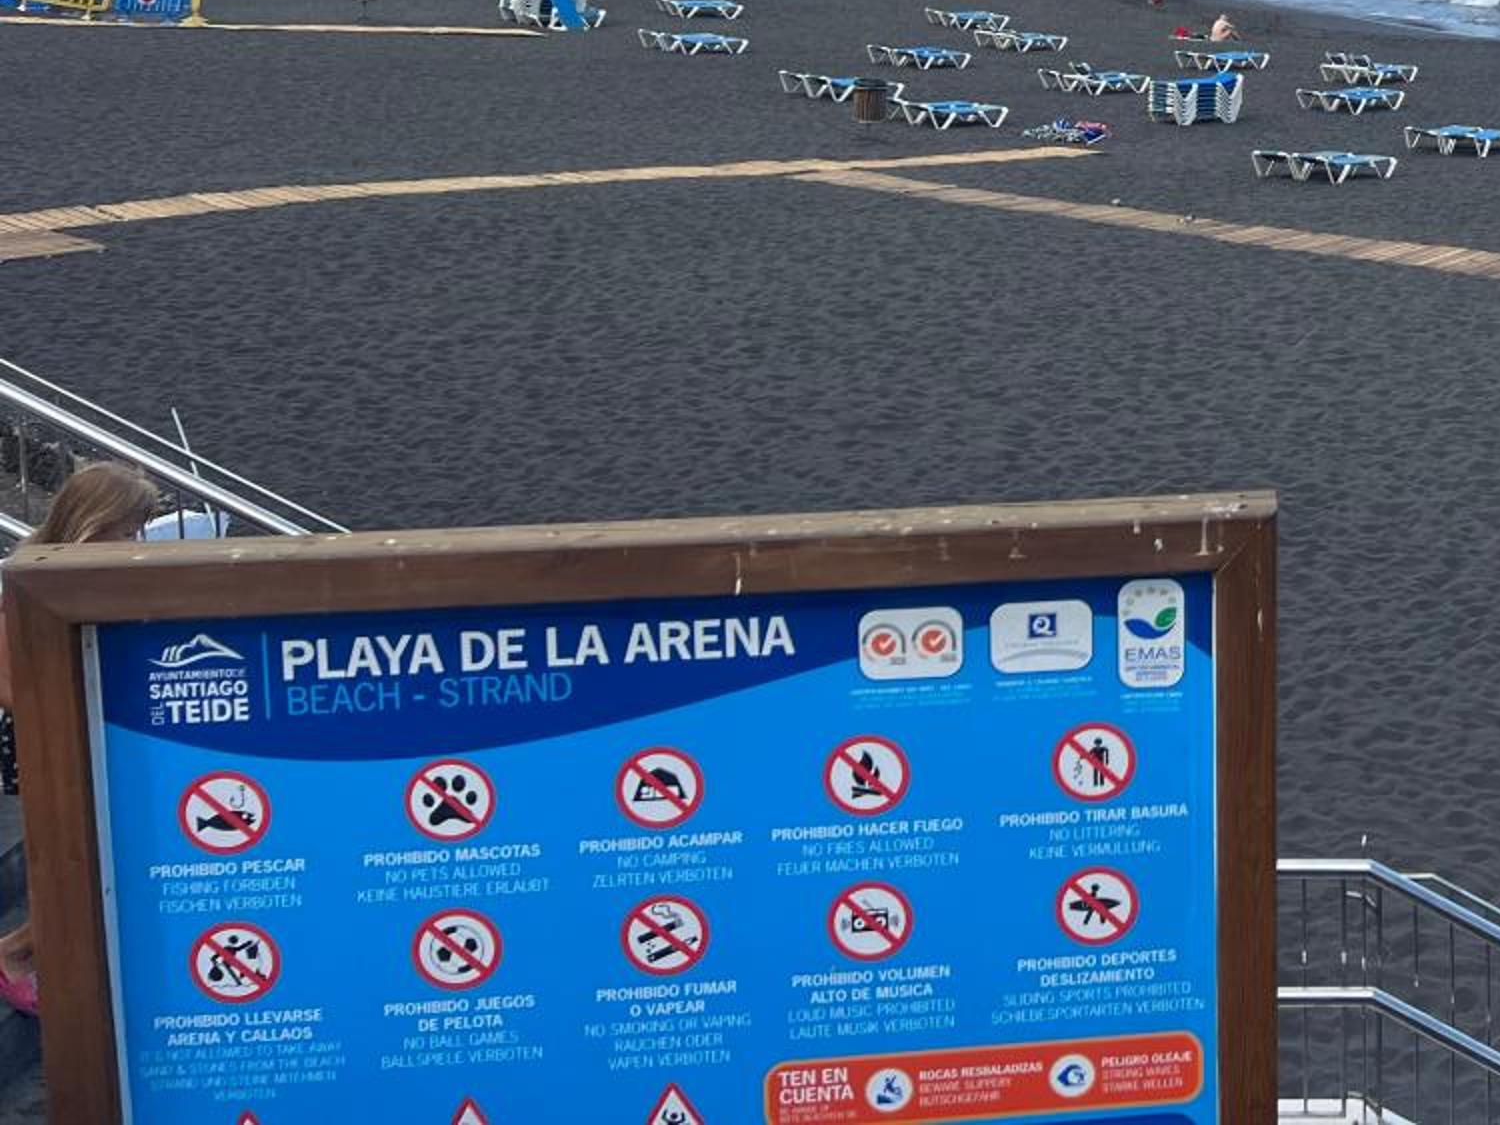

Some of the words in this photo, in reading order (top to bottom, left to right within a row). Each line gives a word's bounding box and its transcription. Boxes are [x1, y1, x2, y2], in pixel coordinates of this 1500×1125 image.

[281, 633, 444, 681] PLAYA
[460, 628, 528, 672] DE
[546, 625, 609, 667] LA
[624, 616, 795, 663] ARENA
[1124, 646, 1181, 662] EMAS
[149, 680, 248, 700] SANTIAGO
[287, 682, 401, 716] BEACH
[439, 673, 573, 708] STRAND
[151, 702, 165, 726] DEL
[165, 698, 250, 724] TEIDE
[1000, 811, 1080, 827] PROHIBIDO
[1084, 808, 1127, 823] TIRAR
[1131, 802, 1188, 820] BASURA
[771, 825, 853, 841] PROHIBIDO
[858, 822, 909, 837] HACER
[913, 818, 964, 833] FUEGO
[1049, 826, 1070, 841] NO
[1073, 823, 1141, 840] LITTERING
[579, 836, 663, 854] PROHIBIDO
[667, 831, 743, 849] ACAMPAR
[802, 843, 823, 857] NO
[827, 840, 865, 856] FIRES
[868, 836, 935, 853] ALLOWED
[1029, 844, 1065, 859] KEINE
[363, 850, 450, 867] PROHIBIDO
[455, 844, 541, 862] MASCOTAS
[617, 855, 639, 869] NO
[643, 851, 707, 868] CAMPING
[777, 860, 821, 876] FEUER
[825, 857, 884, 873] MACHEN
[887, 852, 960, 869] VERBOTEN
[149, 862, 237, 879] PROHIBIDO
[241, 858, 305, 875] PESCAR
[385, 869, 407, 885] NO
[411, 866, 449, 882] PETS
[452, 862, 521, 880] ALLOWED
[658, 867, 733, 884] VERBOTEN
[162, 880, 219, 896] FISHING
[357, 888, 399, 903] KEINE
[403, 883, 481, 901] HAUSTIERE
[486, 878, 549, 896] ERLAUBT
[159, 897, 221, 914] FISCHEN
[225, 894, 303, 912] VERBOTEN
[1017, 955, 1097, 972] PROHIBIDO
[1101, 949, 1177, 967] DEPORTES
[878, 964, 951, 982] VOLUMEN
[1040, 967, 1155, 988] DESLIZAMIENTO
[596, 984, 680, 1002] PROHIBIDO
[685, 980, 737, 996] FUMAR
[810, 989, 847, 1004] ALTO
[851, 987, 872, 1001] DE
[1059, 987, 1113, 1003] SPORTS
[1115, 981, 1192, 1000] PROHIBITED
[383, 999, 469, 1016] PROHIBIDO
[474, 994, 536, 1012] JUEGOS
[630, 1004, 642, 1018] O
[646, 1000, 705, 1017] VAPEAR
[787, 1008, 827, 1023] LOUD
[829, 1004, 874, 1020] MUSIC
[876, 998, 956, 1017] PROHIBITED
[1136, 997, 1205, 1014] VERBOTEN
[153, 1012, 240, 1030] PROHIBIDO
[244, 1008, 322, 1026] LLEVARSE
[418, 1018, 440, 1032] DE
[444, 1014, 503, 1031] PELOTA
[584, 1024, 606, 1038] NO
[610, 1020, 675, 1036] SMOKING
[679, 1017, 698, 1031] OR
[702, 1013, 752, 1029] VAPING
[789, 1025, 833, 1040] LAUTE
[837, 1021, 880, 1037] MUSIK
[883, 1015, 956, 1033] VERBOTEN
[167, 1031, 221, 1047] ARENA
[225, 1030, 236, 1044] Y
[240, 1026, 313, 1042] CALLAOS
[403, 1036, 425, 1051] NO
[429, 1034, 465, 1049] BALL
[469, 1030, 520, 1046] GAMES
[614, 1035, 682, 1053] RAUCHEN
[686, 1032, 723, 1047] ODER
[381, 1051, 465, 1069] BALLSPIELE
[468, 1046, 543, 1064] VERBOTEN
[608, 1055, 653, 1071] VAPEN
[657, 1050, 731, 1067] VERBOTEN
[1101, 1054, 1149, 1068] PELIGRO
[1151, 1050, 1193, 1064] OLEAJE
[777, 1069, 817, 1087] TEN
[821, 1066, 848, 1084] EN
[919, 1068, 959, 1081] ROCAS
[961, 1061, 1043, 1077] RESBALADIZAS
[779, 1084, 855, 1104] CUENTA
